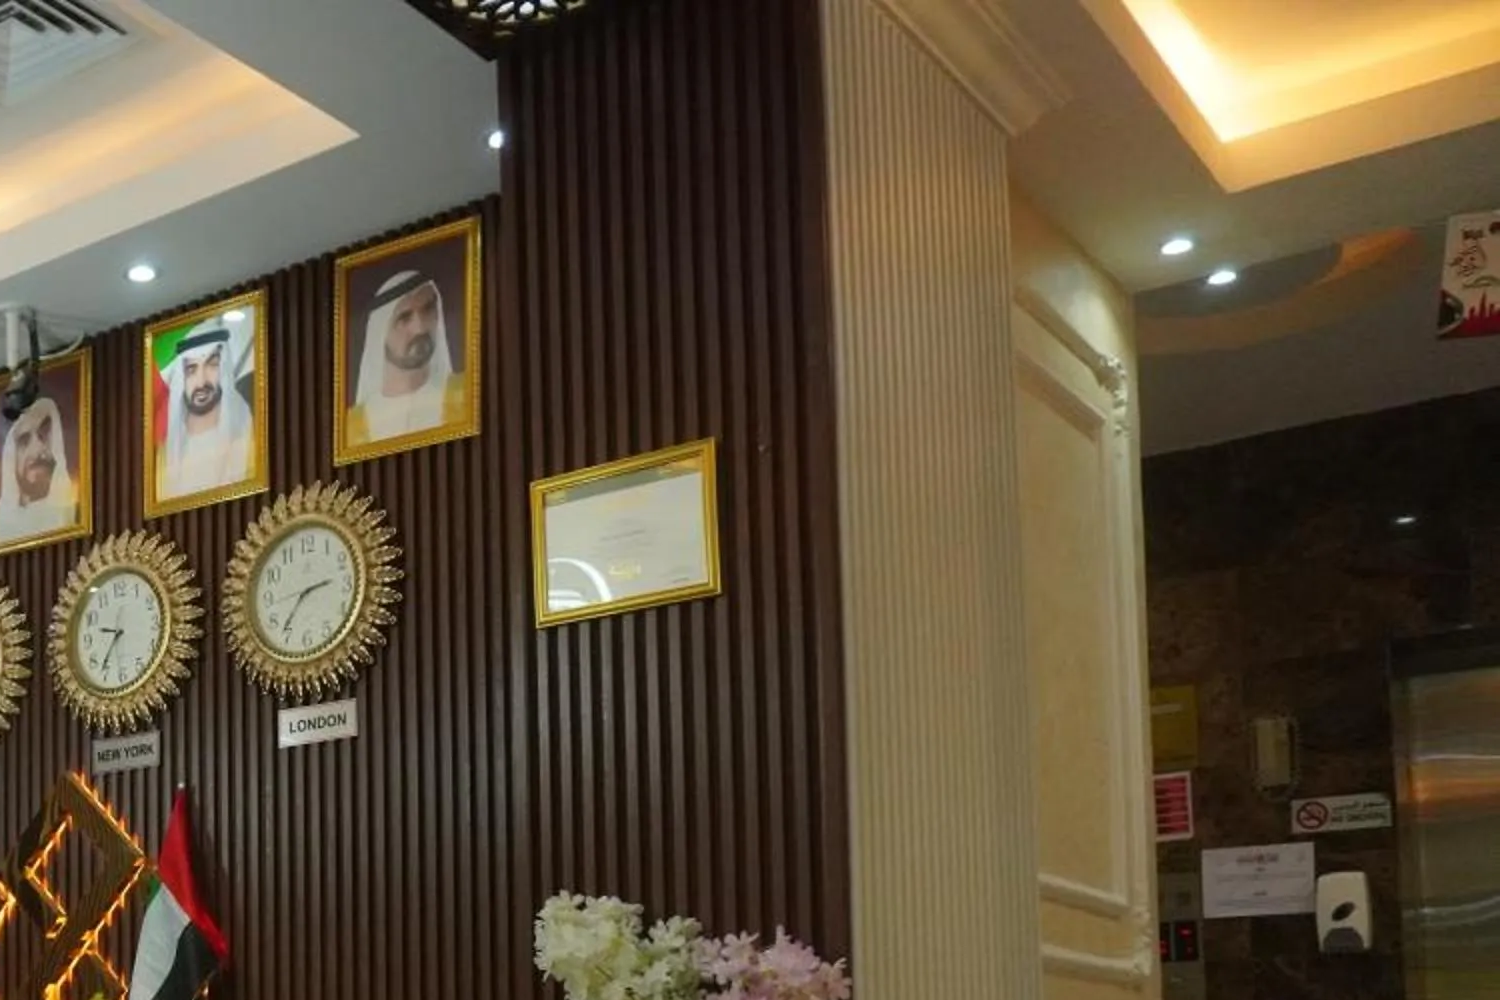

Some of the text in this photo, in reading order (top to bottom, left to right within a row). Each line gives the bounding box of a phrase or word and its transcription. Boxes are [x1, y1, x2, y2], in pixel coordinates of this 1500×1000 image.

[300, 535, 315, 553] 12
[281, 547, 294, 564] 11
[266, 567, 281, 584] 10
[113, 580, 127, 598] 12
[288, 711, 347, 735] LONDON
[97, 742, 154, 763] NEW YORK
